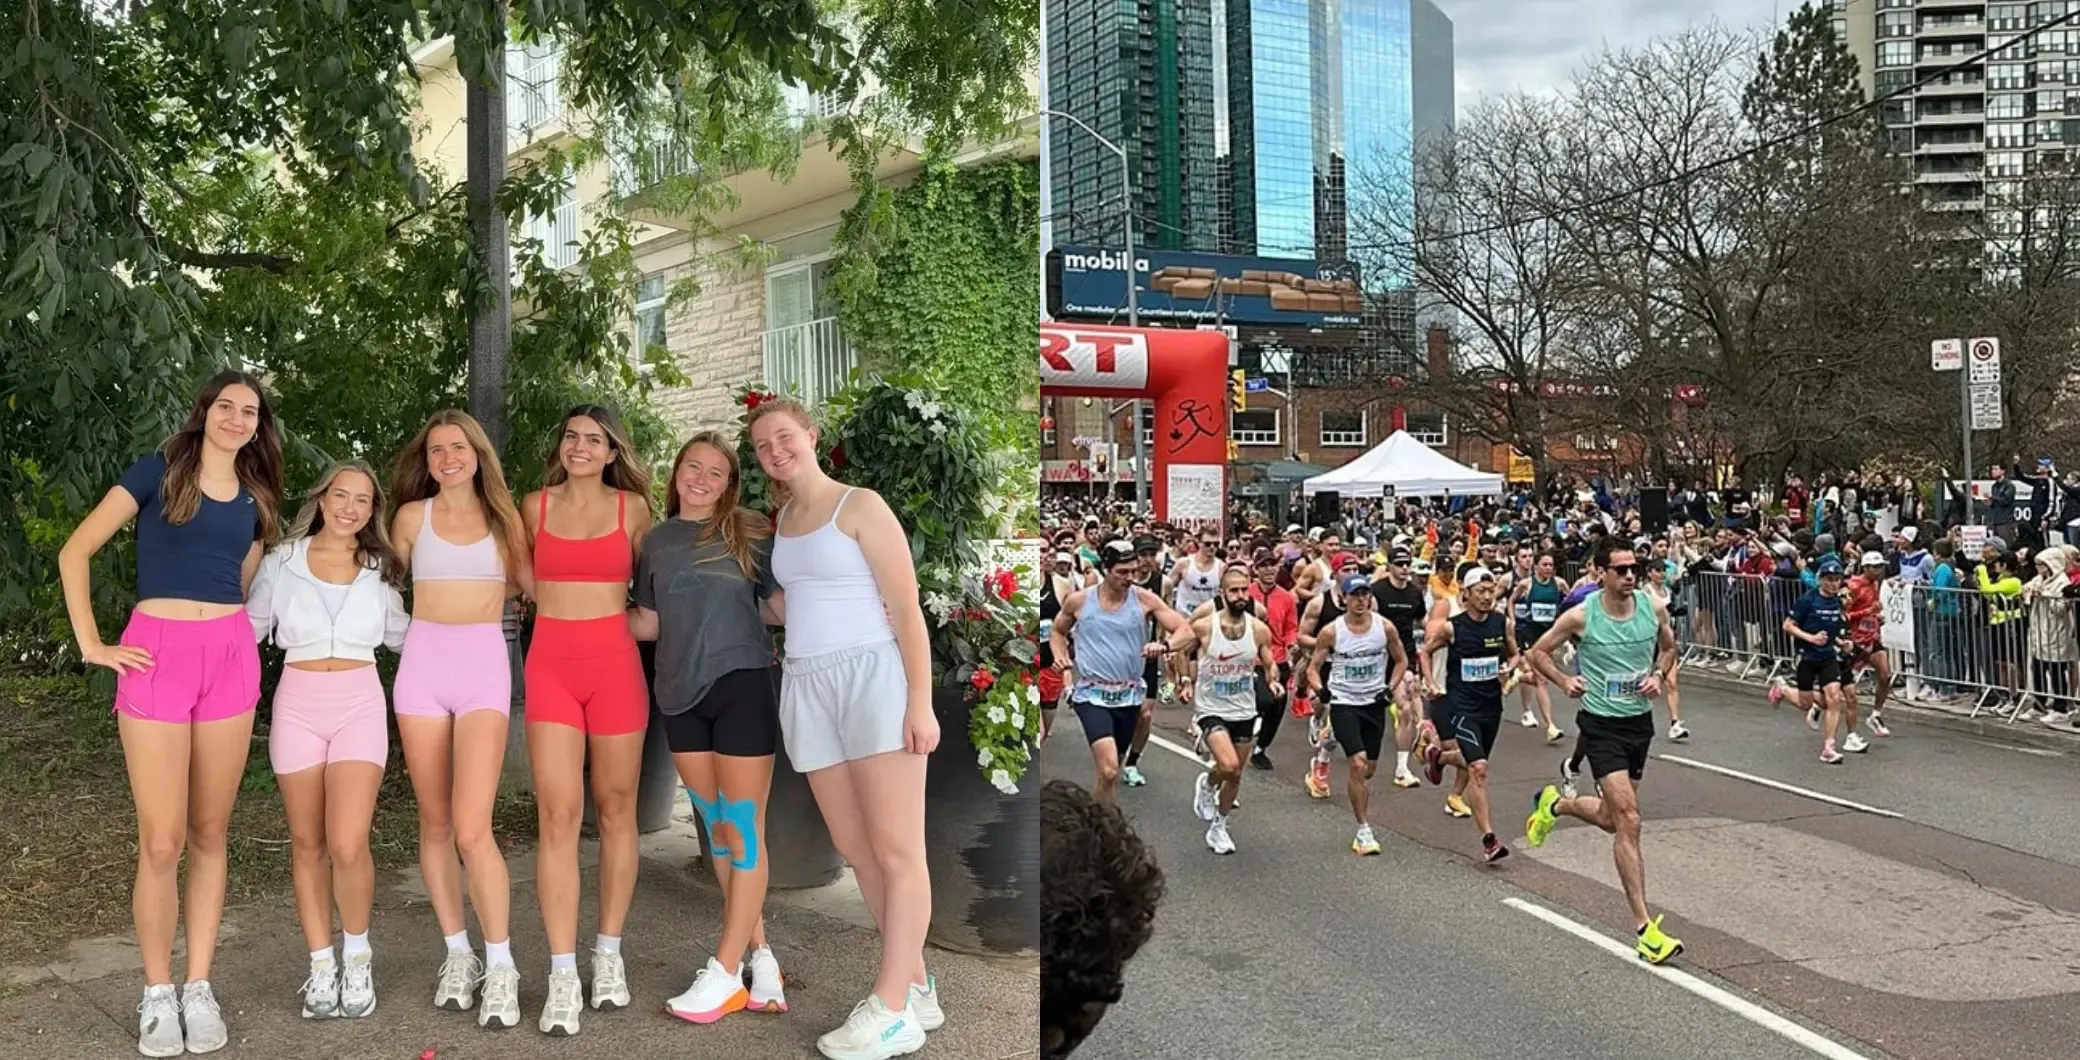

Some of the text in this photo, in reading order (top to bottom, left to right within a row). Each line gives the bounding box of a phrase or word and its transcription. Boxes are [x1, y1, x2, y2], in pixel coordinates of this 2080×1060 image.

[1065, 250, 1149, 272] mobila
[1066, 303, 1082, 312] One
[1084, 304, 1116, 313] modular
[1137, 306, 1173, 316] Countless
[1941, 342, 1952, 351] NO
[1210, 663, 1235, 676] STOP
[880, 1018, 905, 1041] HOKA
